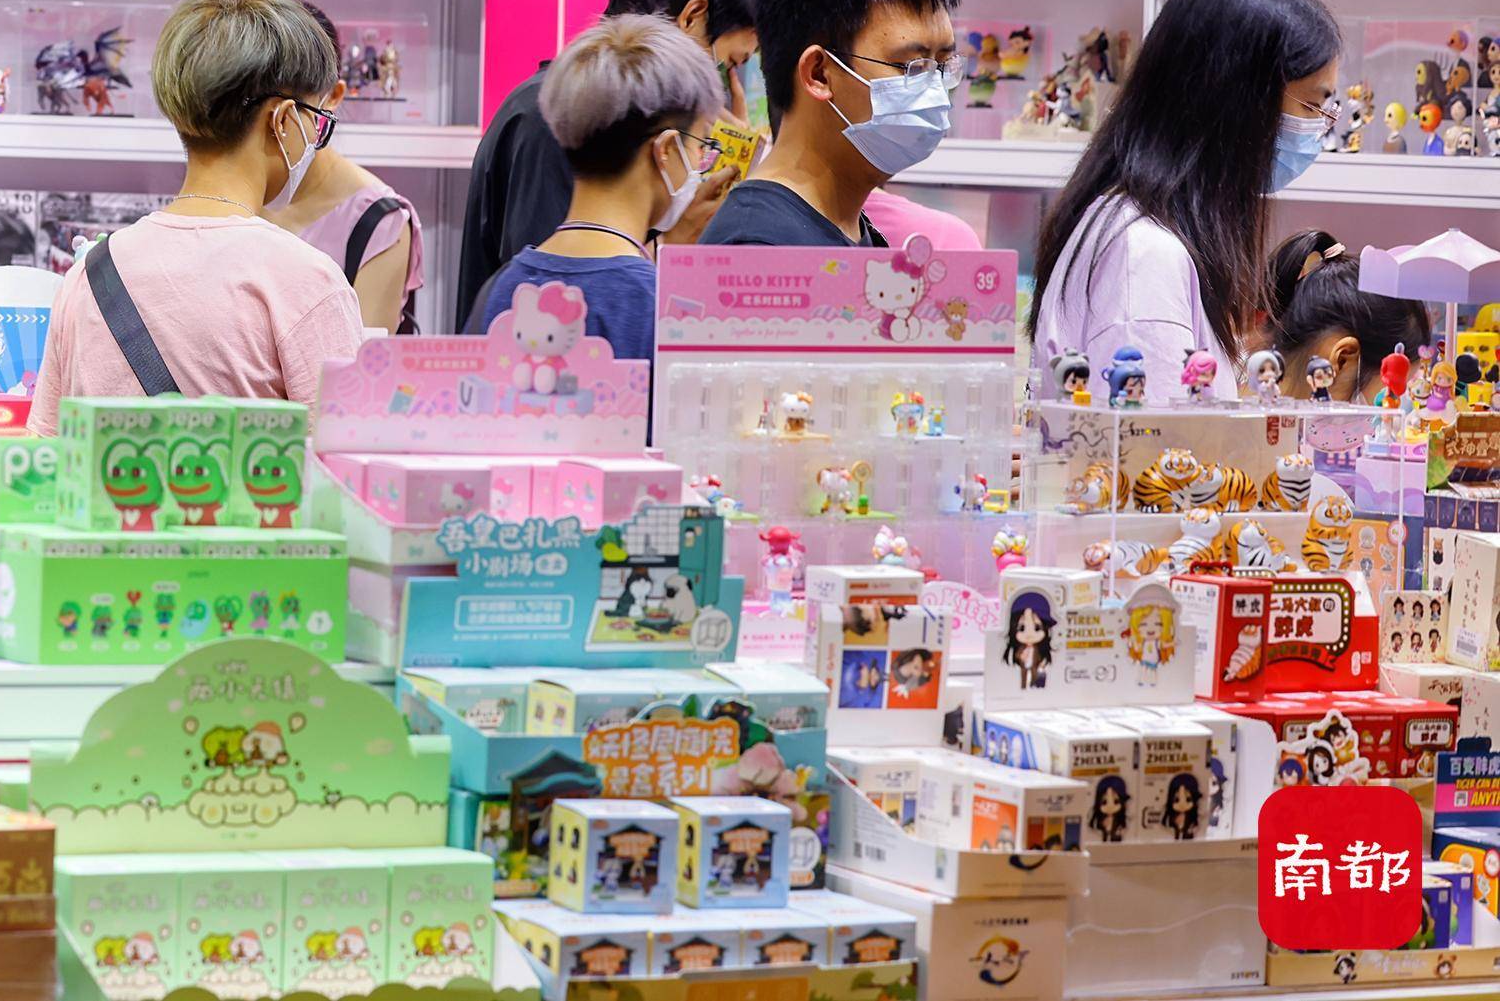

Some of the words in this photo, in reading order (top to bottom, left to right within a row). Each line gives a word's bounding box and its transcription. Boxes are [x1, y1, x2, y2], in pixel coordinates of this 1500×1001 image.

[717, 275, 762, 288] HELLO
[766, 275, 813, 288] KITTY
[442, 515, 582, 553] 吾皇巴扎黑
[1066, 615, 1101, 626] YIREN
[1066, 627, 1106, 639] ZHIXIA
[1072, 742, 1110, 754] YIREN
[1144, 740, 1183, 752] YIREN
[1072, 754, 1116, 766] ZHIXIA
[1145, 752, 1189, 764] ZHIXIA
